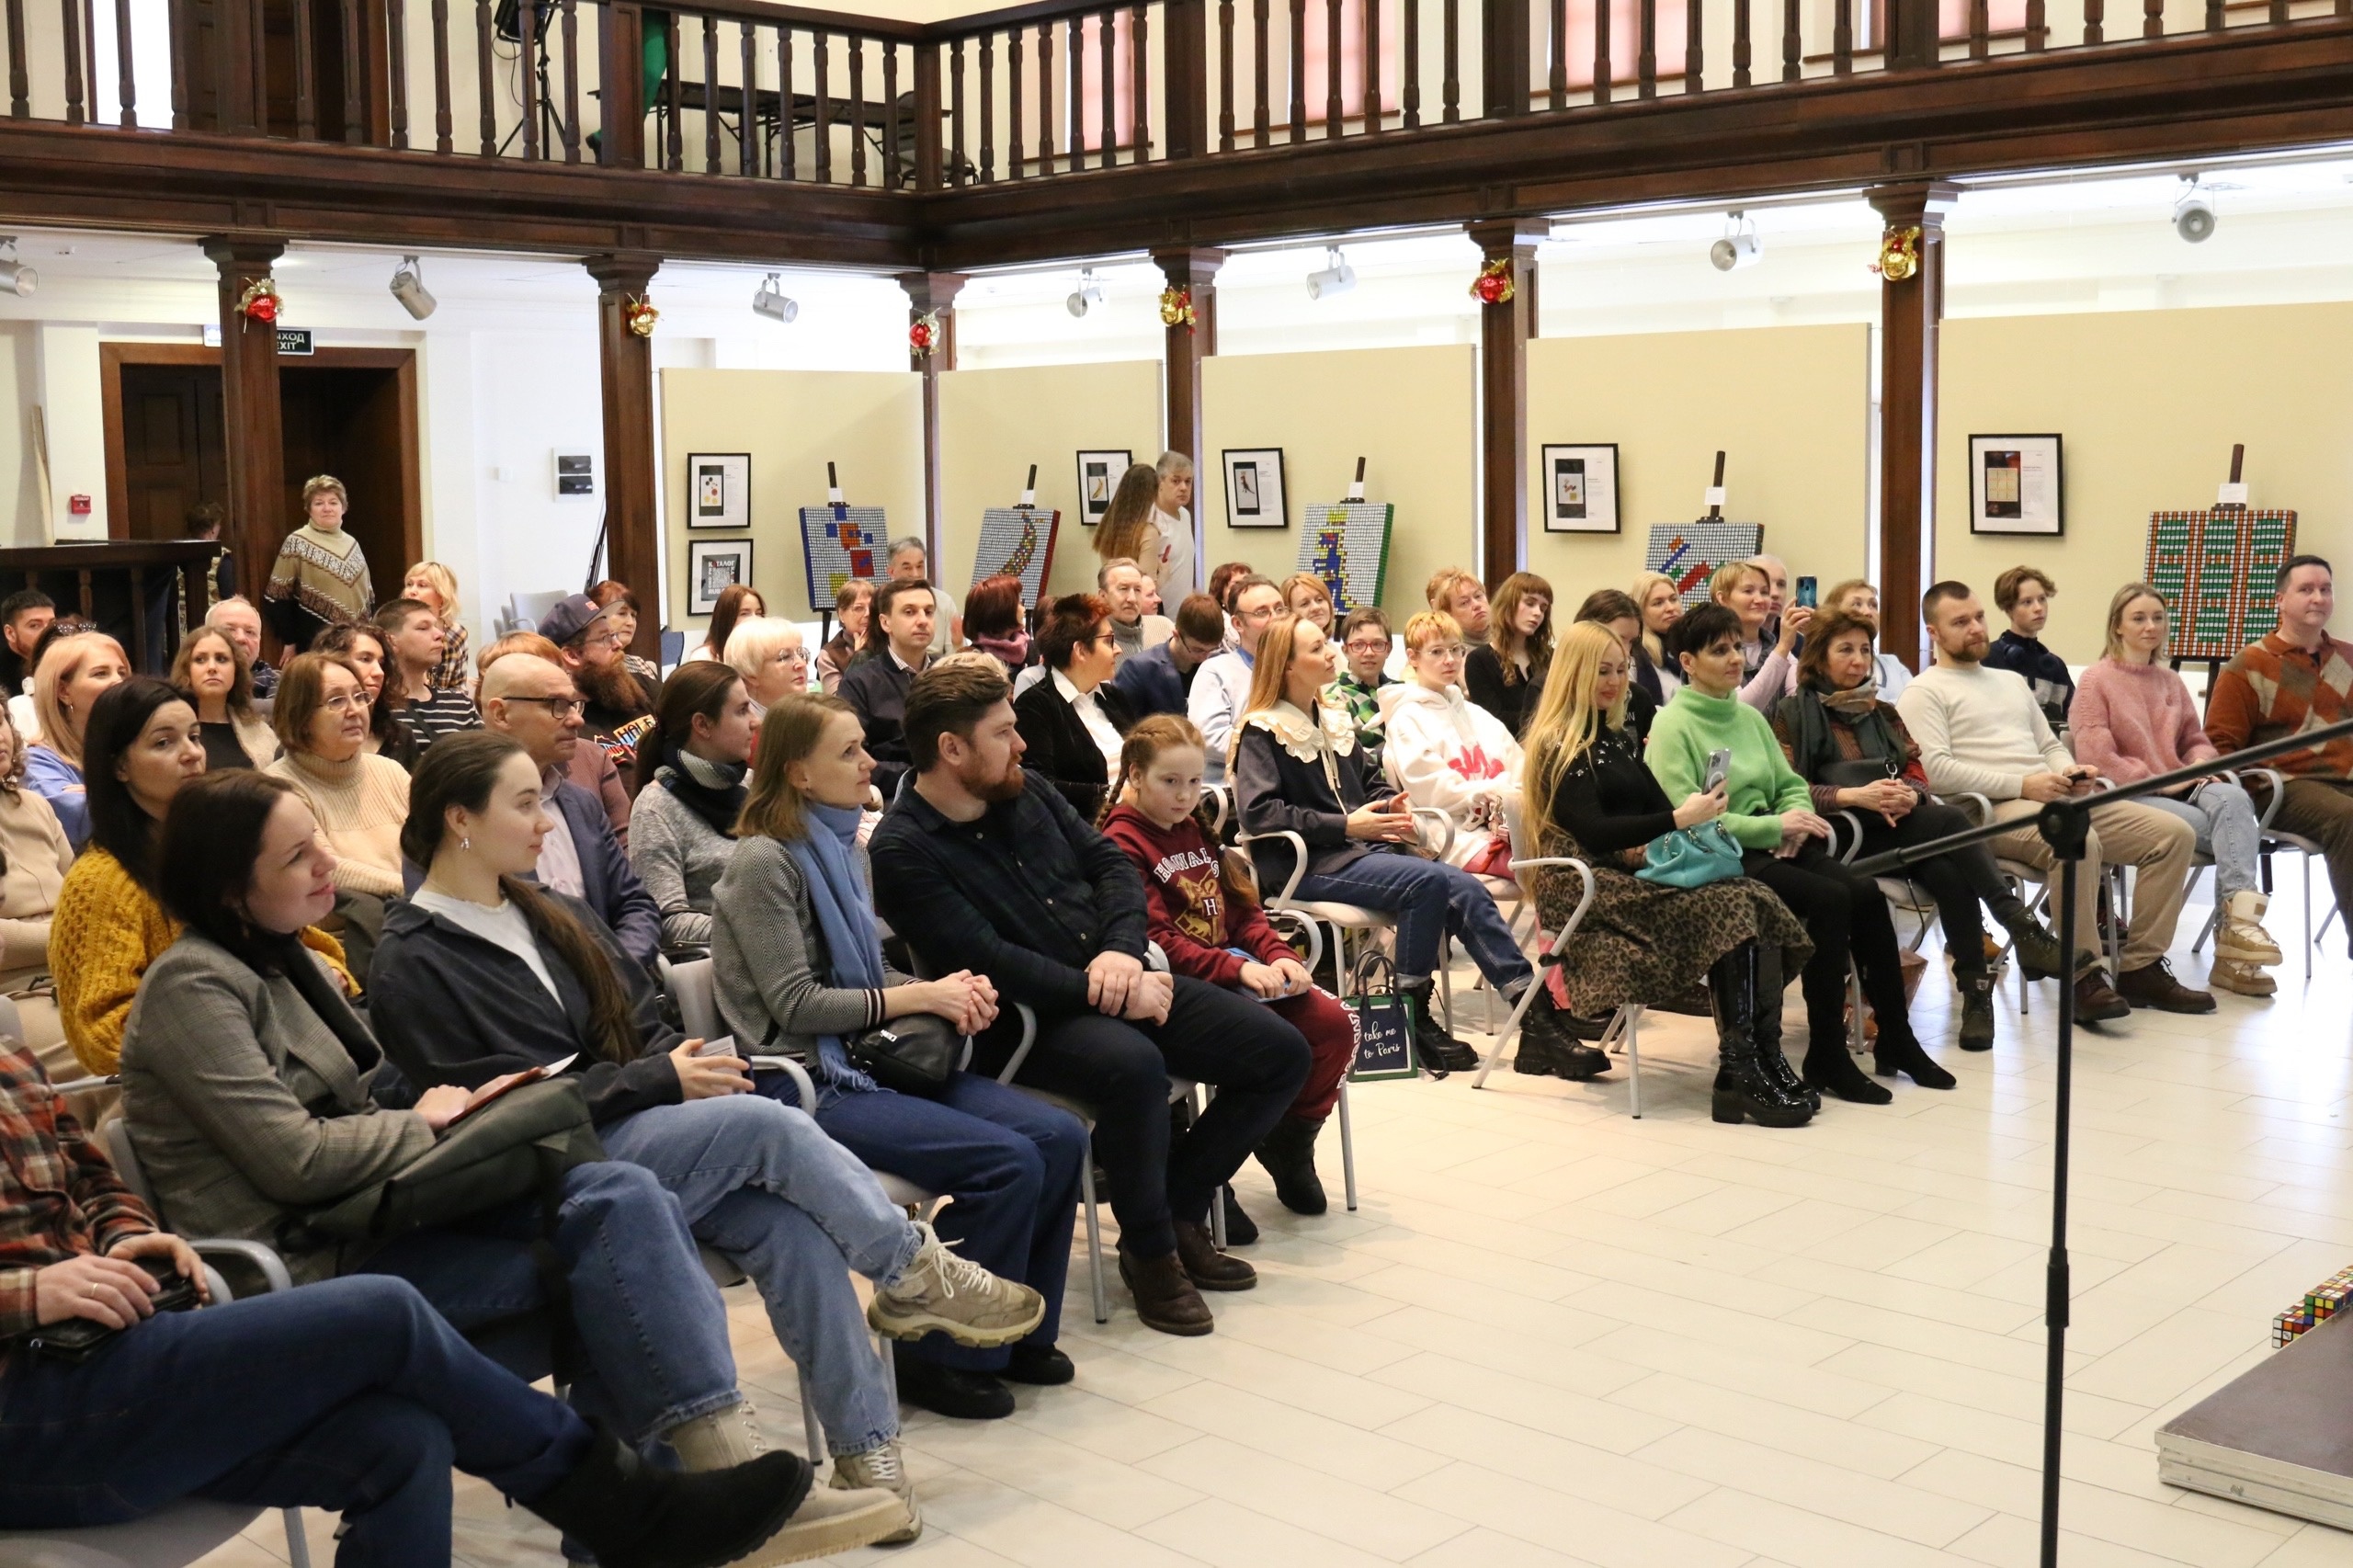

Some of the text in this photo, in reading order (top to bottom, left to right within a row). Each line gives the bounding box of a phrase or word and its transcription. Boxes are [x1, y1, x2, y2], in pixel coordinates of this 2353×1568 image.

[1203, 898, 1218, 915] H
[1363, 1021, 1396, 1041] take me
[1363, 1042, 1401, 1059] to Paris
